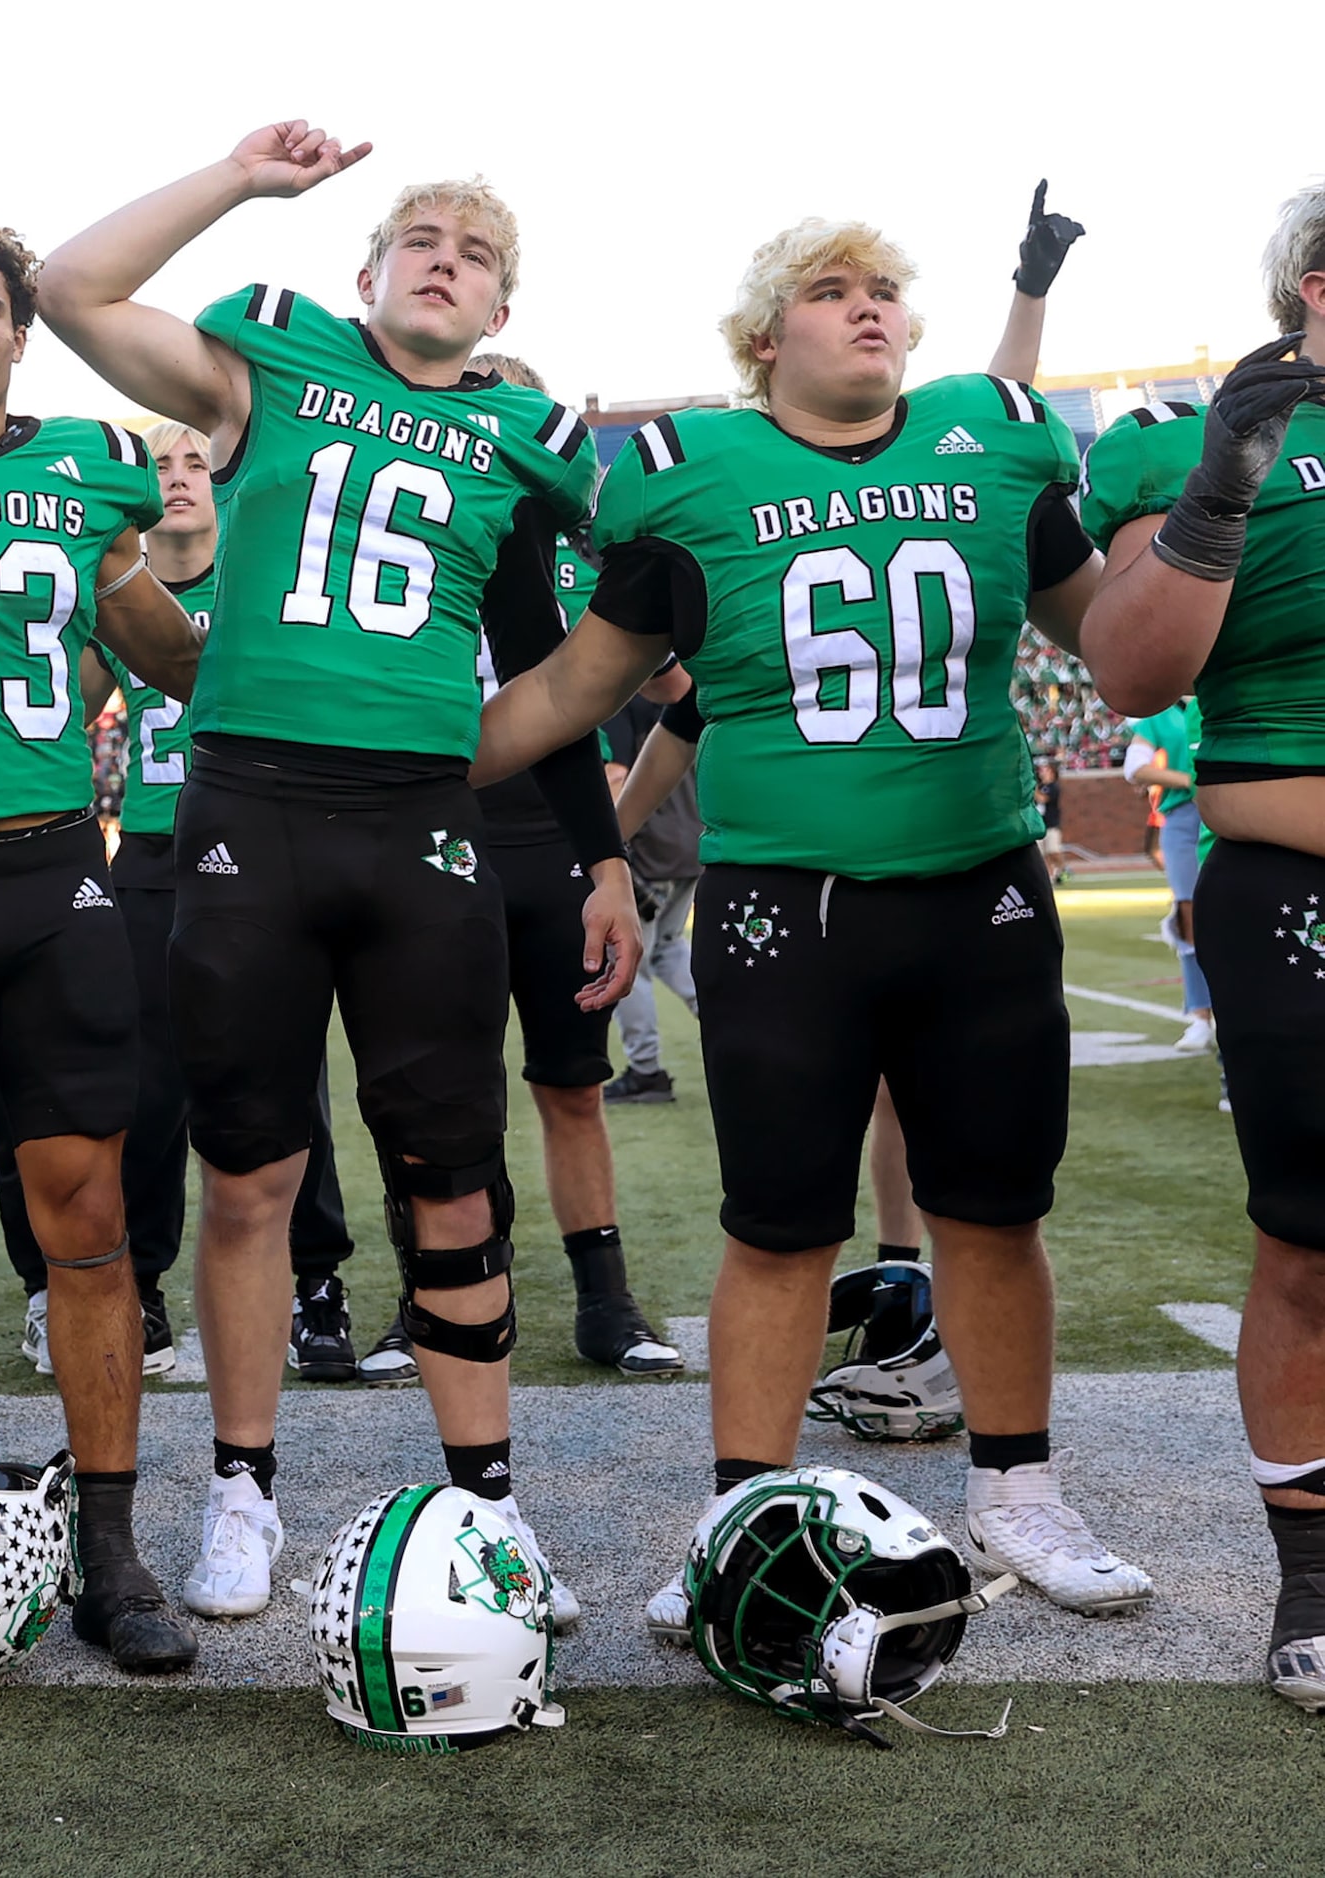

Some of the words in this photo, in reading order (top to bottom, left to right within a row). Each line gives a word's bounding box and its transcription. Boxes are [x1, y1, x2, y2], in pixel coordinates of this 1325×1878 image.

[297, 379, 495, 474] DRAGONS
[934, 442, 984, 455] adidas
[751, 482, 979, 545] DRAGONS
[279, 440, 454, 640] 16
[780, 538, 976, 745] 60
[196, 859, 239, 876] adidas
[72, 896, 113, 910] adidas
[991, 906, 1035, 926] adidas
[399, 1685, 426, 1718] 6
